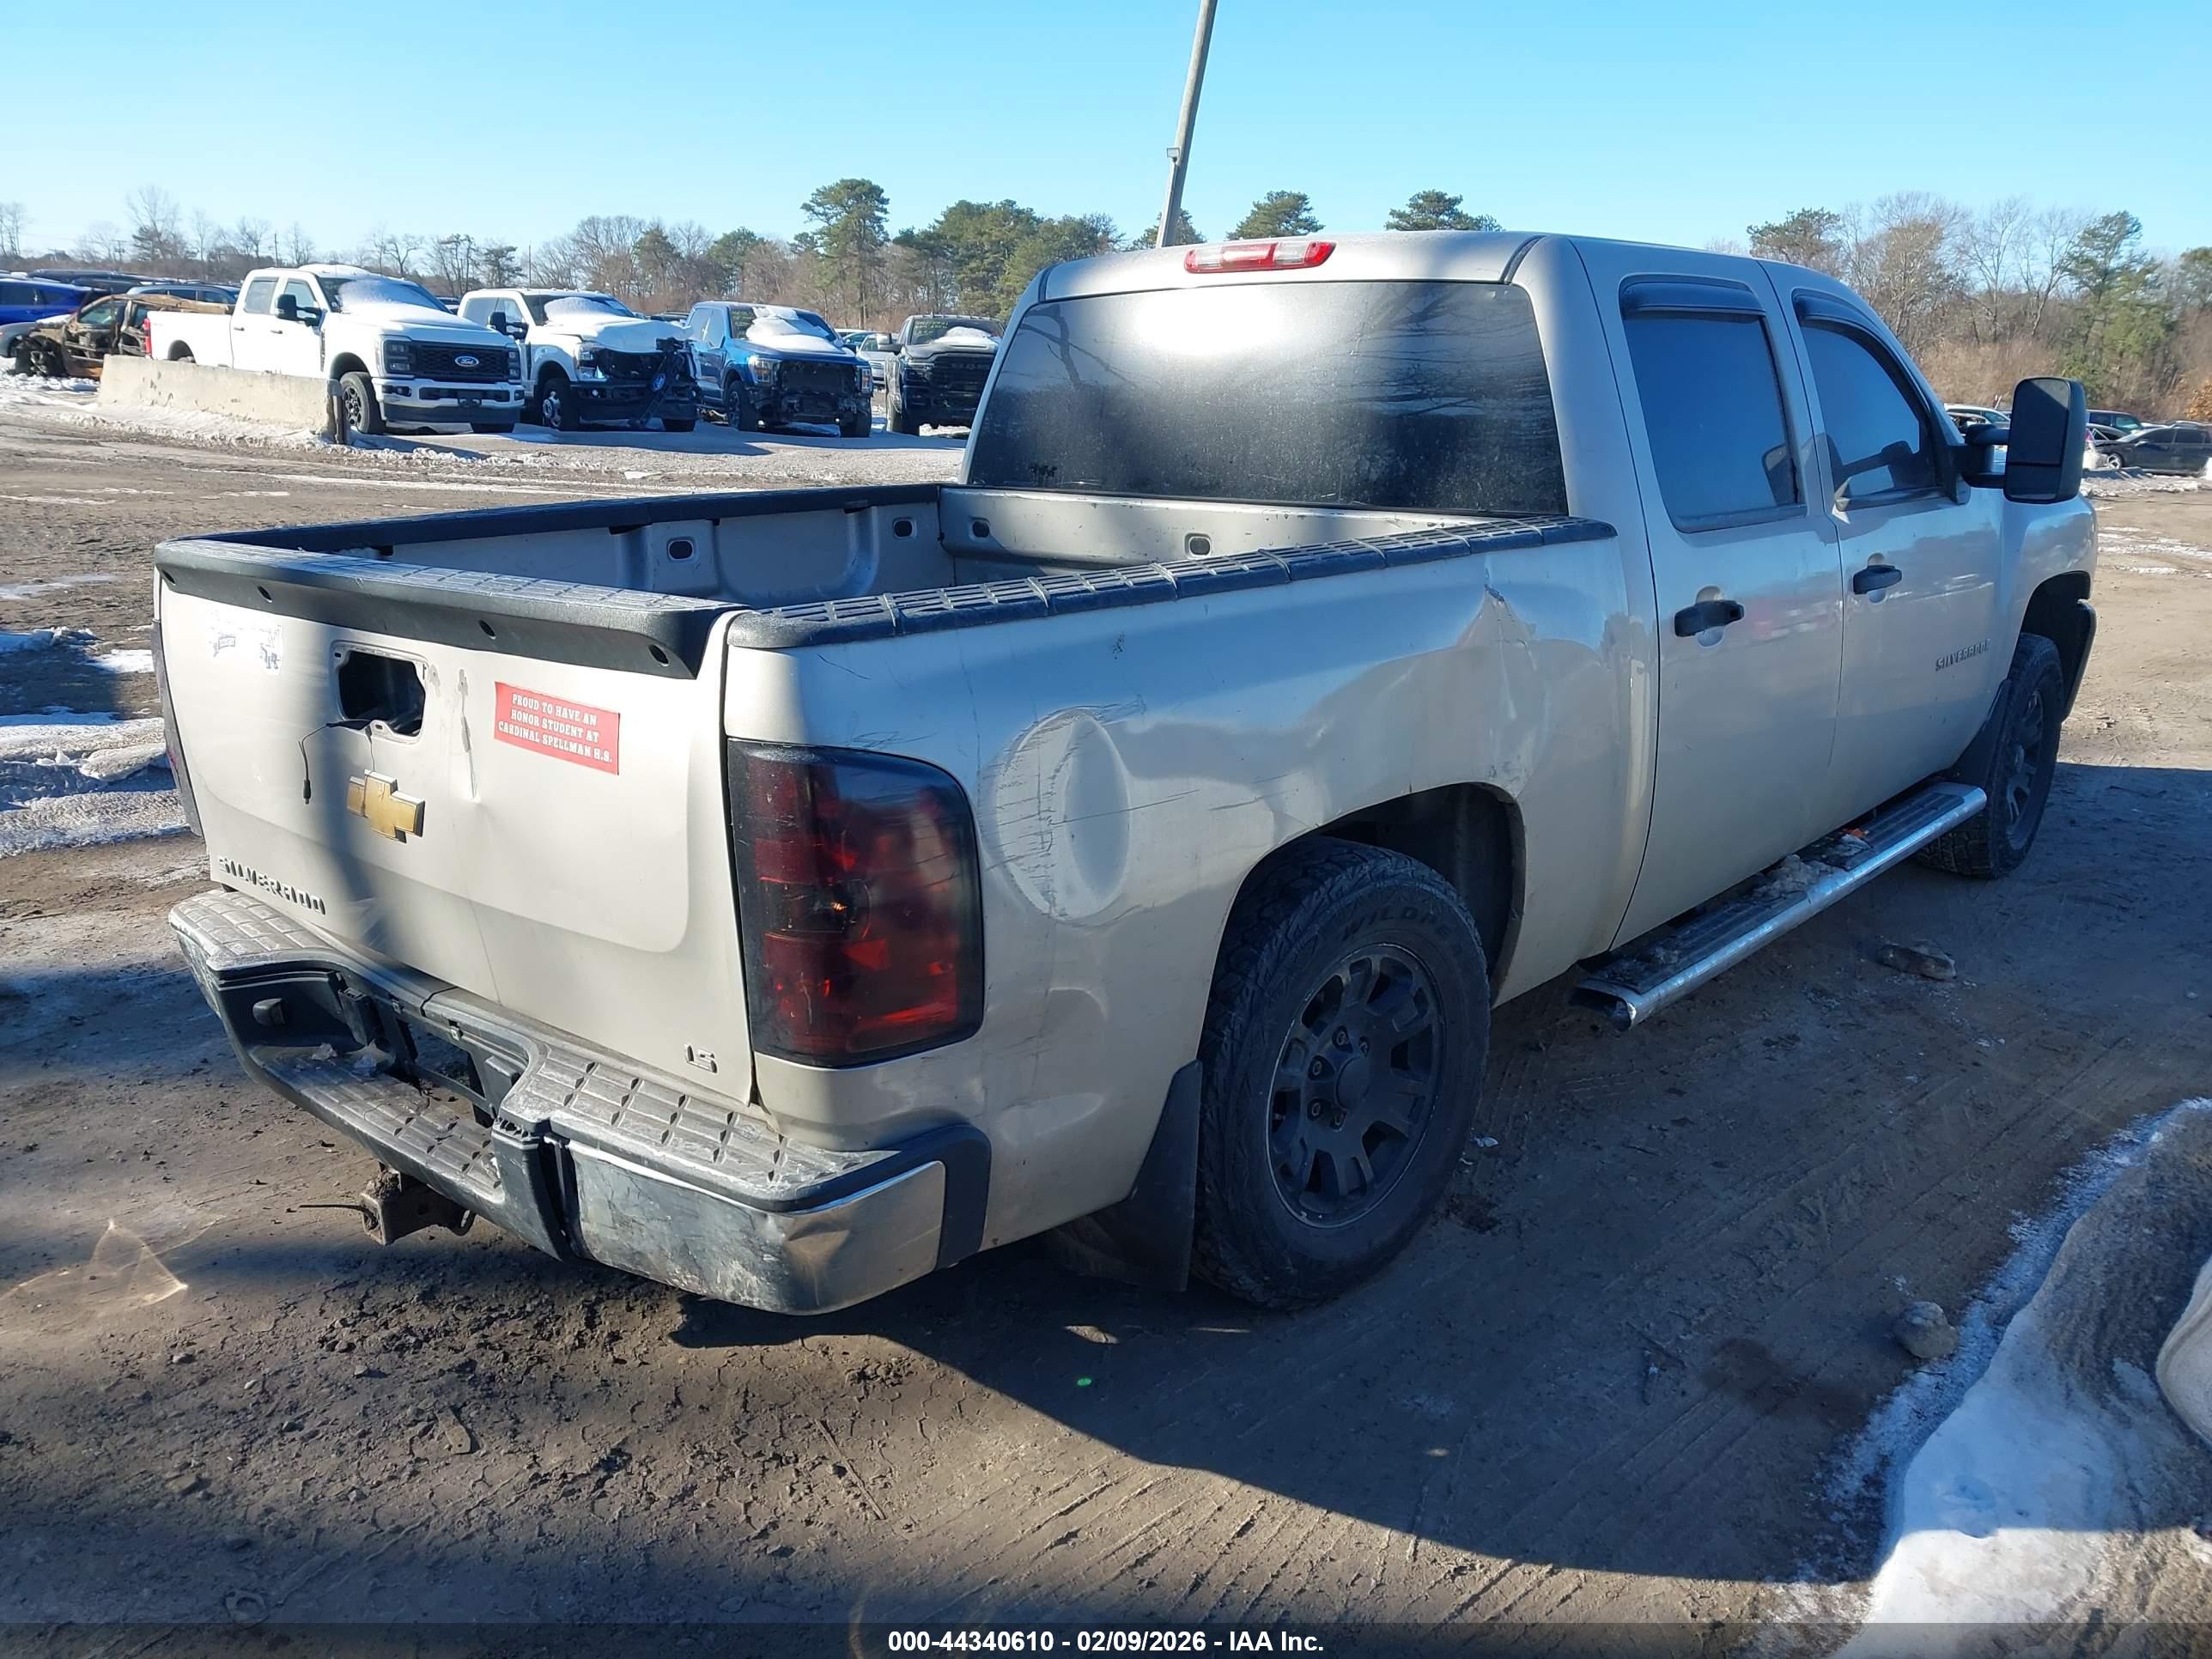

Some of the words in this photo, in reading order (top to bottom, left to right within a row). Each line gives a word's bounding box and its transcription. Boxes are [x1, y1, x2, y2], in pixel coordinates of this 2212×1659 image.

[510, 708, 540, 727] HONOR
[541, 718, 584, 738] STUDENT
[585, 729, 599, 744] AT
[512, 693, 539, 711] PROUD
[541, 702, 553, 714] TO
[555, 705, 580, 722] HAVE
[582, 713, 598, 726] AN
[498, 720, 540, 743] CARDINAL
[541, 733, 592, 757] SPELLMAN
[593, 747, 612, 763] H.S.
[684, 1044, 718, 1074] LS
